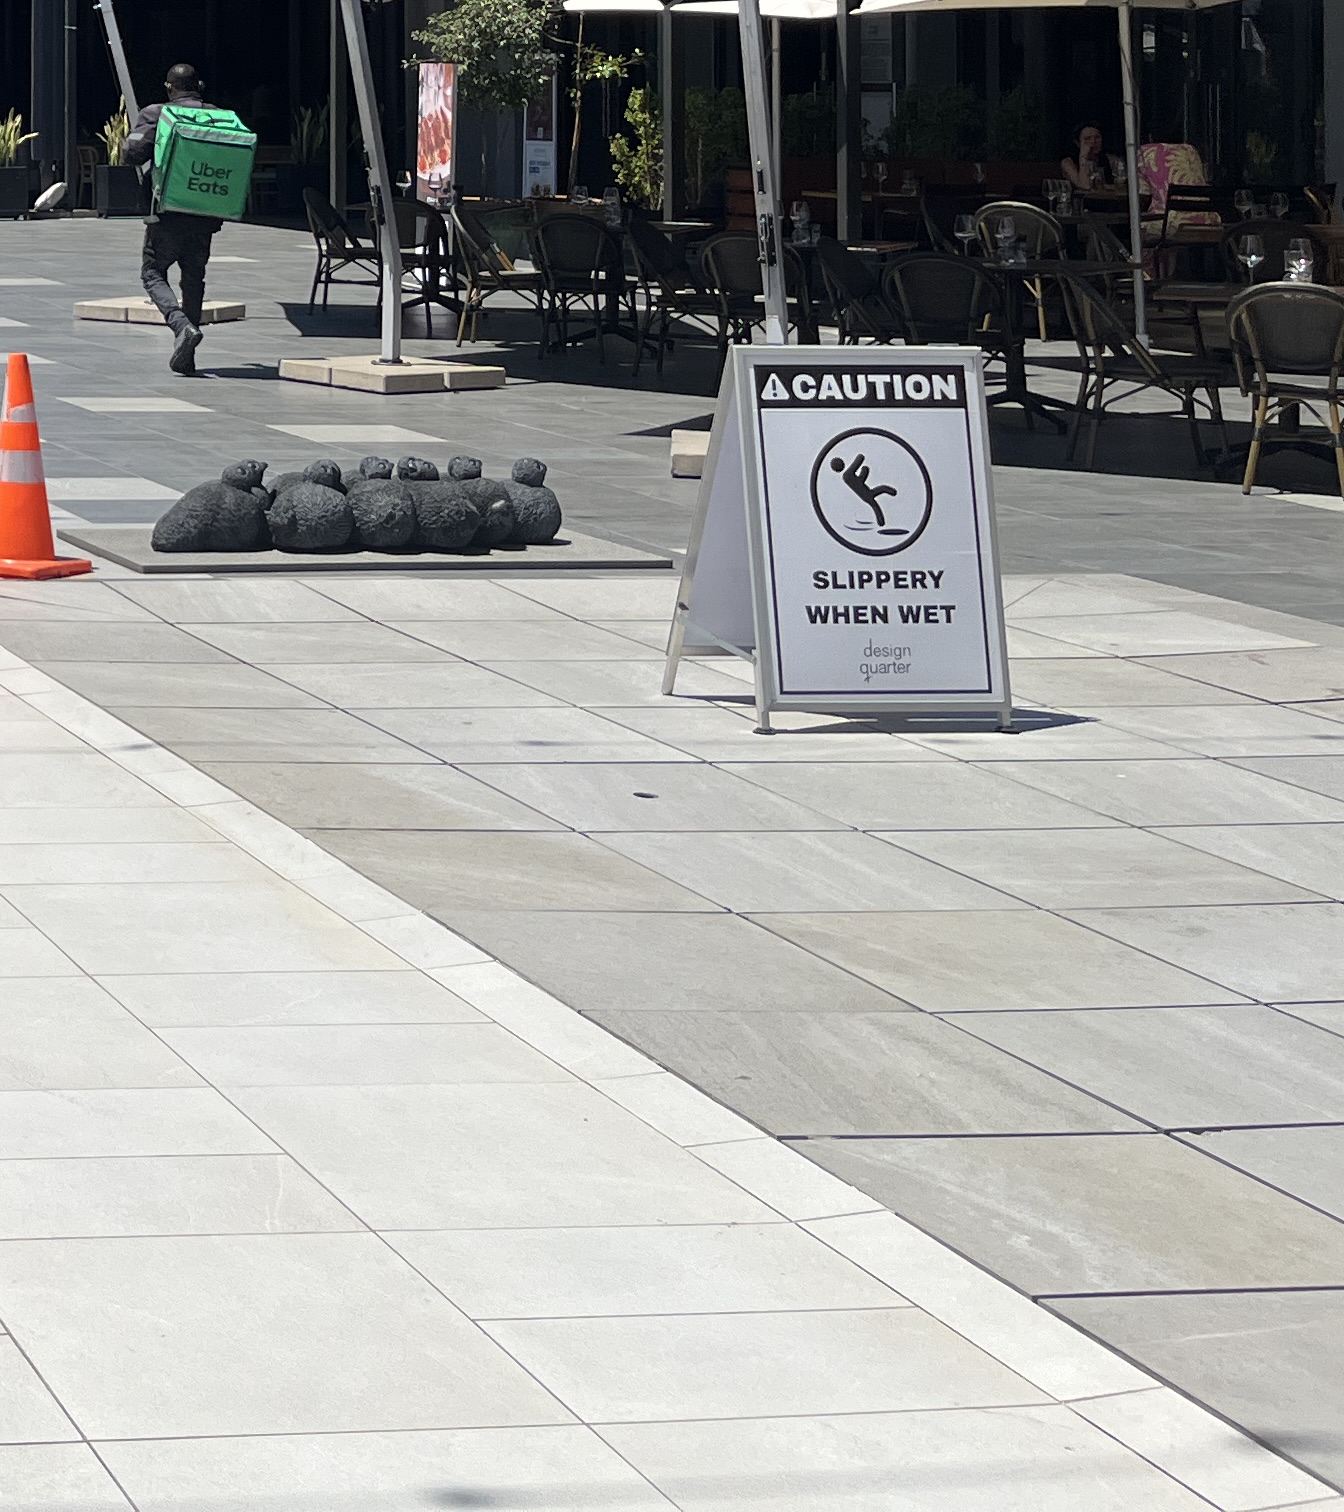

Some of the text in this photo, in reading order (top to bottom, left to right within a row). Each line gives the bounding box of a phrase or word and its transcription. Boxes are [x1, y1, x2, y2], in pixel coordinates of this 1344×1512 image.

[191, 160, 233, 180] Uber
[187, 176, 230, 196] Eats
[791, 373, 958, 401] CAUTION
[812, 570, 945, 590] SLIPPERY
[805, 604, 957, 624] WHEN WET
[863, 637, 912, 660] design
[859, 661, 912, 683] quarter
